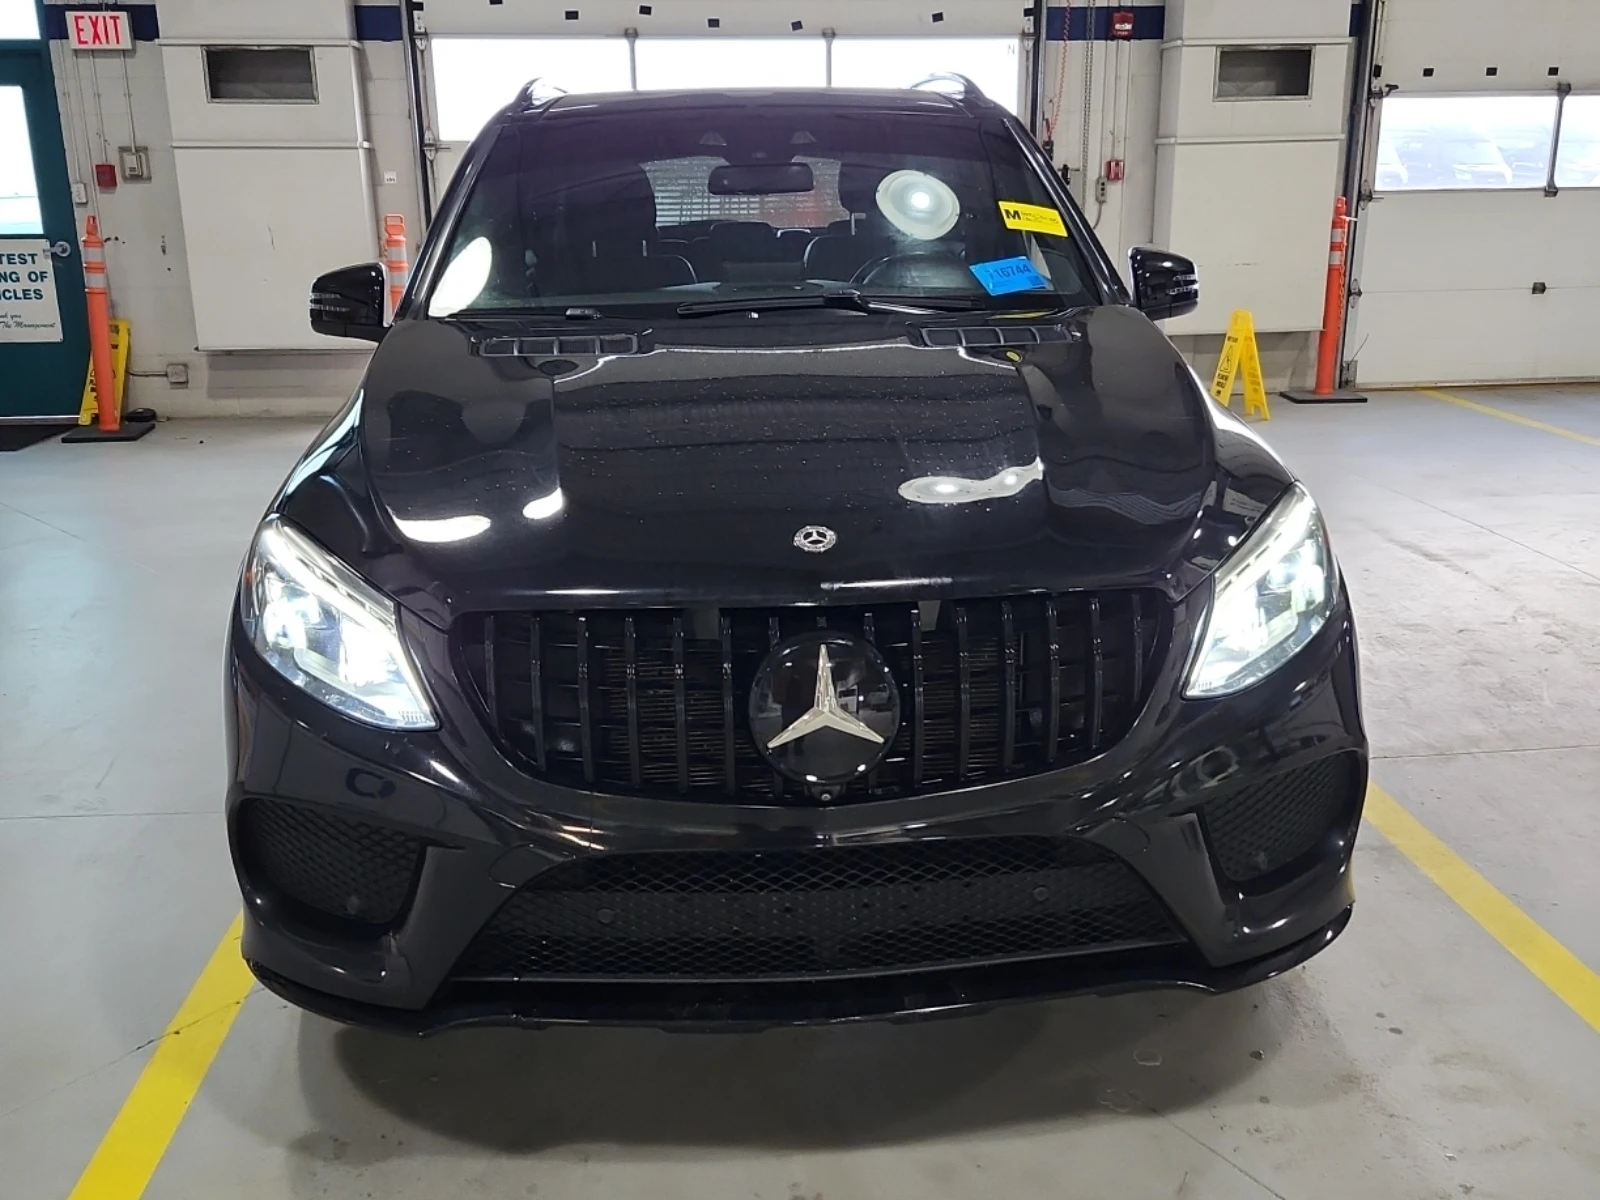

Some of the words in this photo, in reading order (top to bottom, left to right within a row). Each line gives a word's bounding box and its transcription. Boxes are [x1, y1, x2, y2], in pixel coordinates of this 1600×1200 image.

[74, 15, 120, 45] EXIT
[1003, 208, 1022, 221] M
[27, 271, 48, 283] OF
